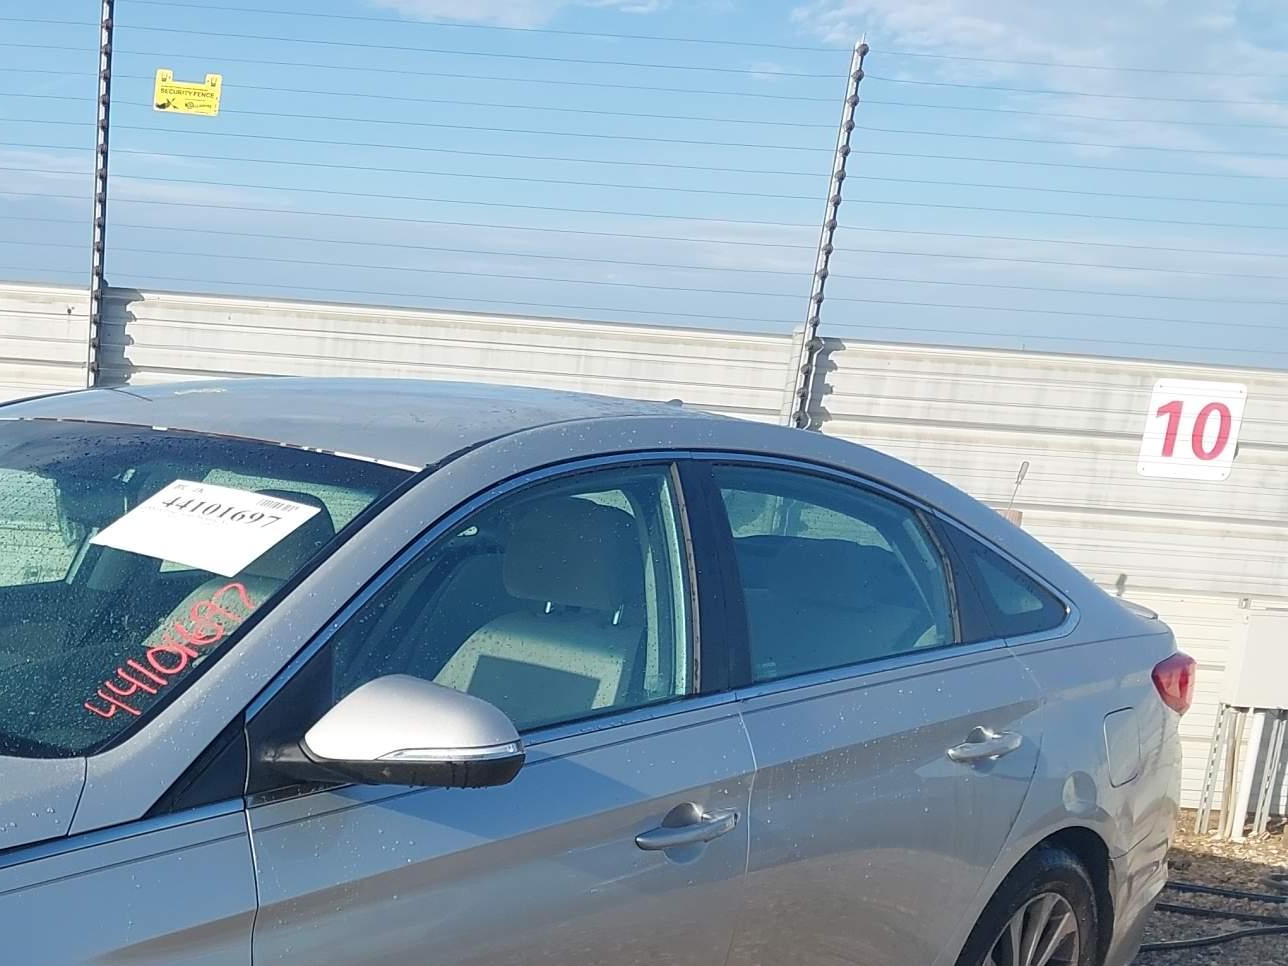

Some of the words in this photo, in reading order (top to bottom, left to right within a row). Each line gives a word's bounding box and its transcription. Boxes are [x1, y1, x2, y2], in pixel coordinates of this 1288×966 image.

[160, 88, 193, 96] SECURITY
[193, 90, 215, 98] FENCE
[1155, 400, 1232, 461] 10
[162, 496, 283, 528] 44101697
[83, 582, 255, 719] 44101697
